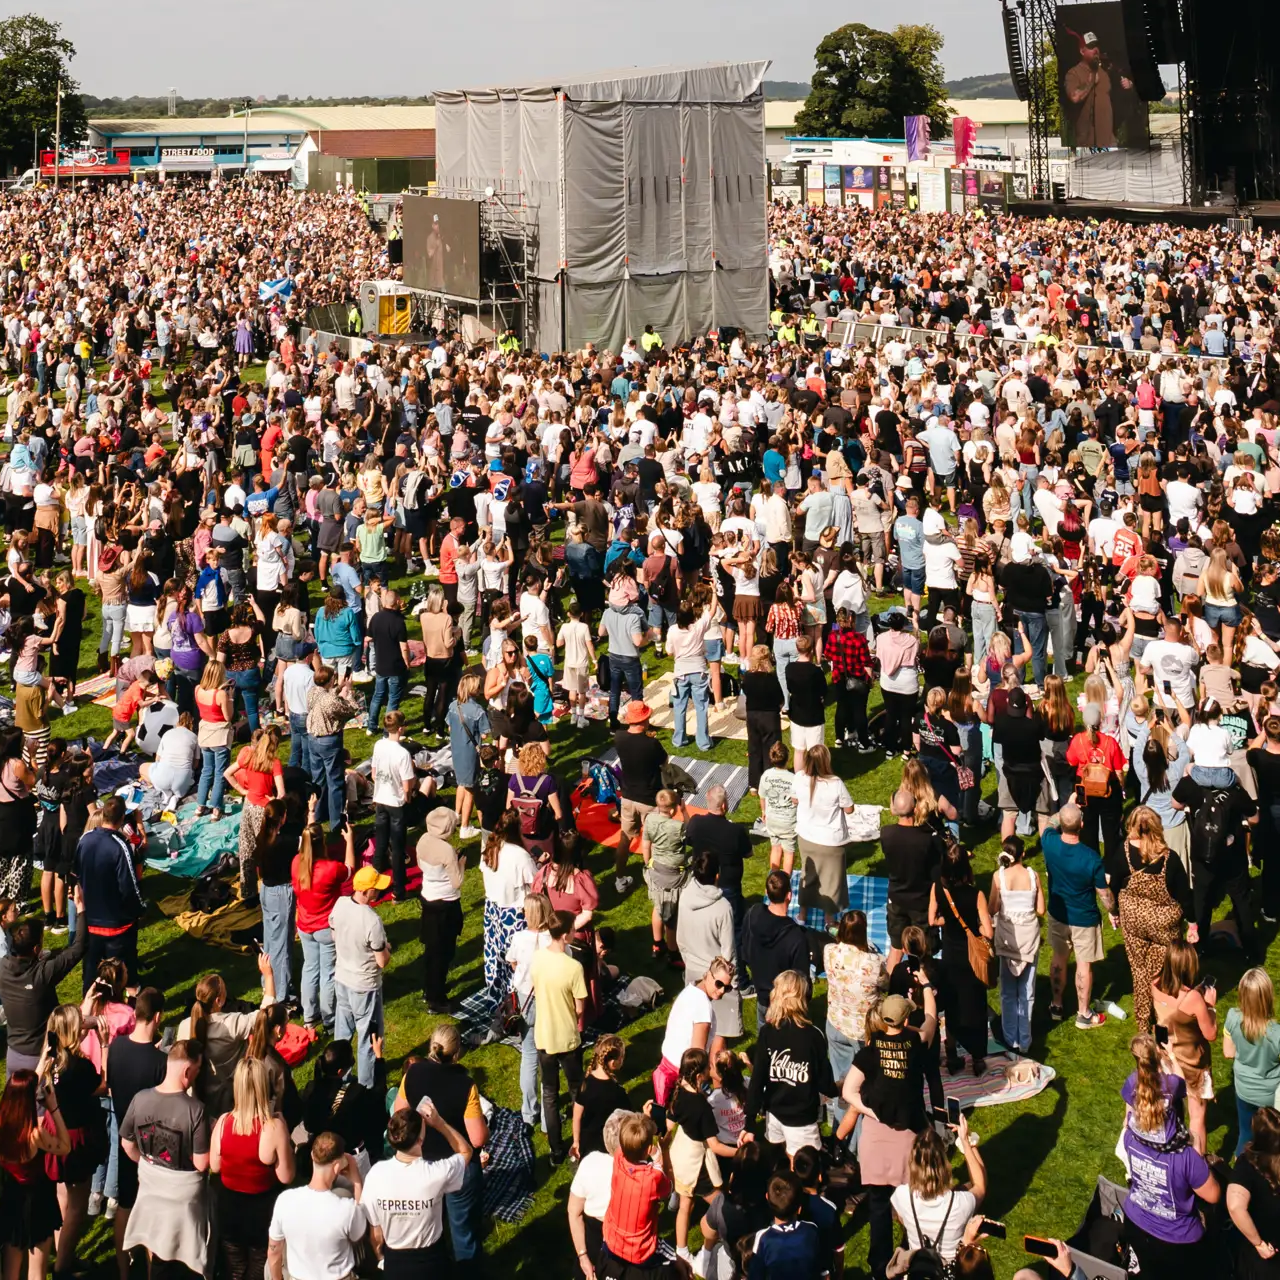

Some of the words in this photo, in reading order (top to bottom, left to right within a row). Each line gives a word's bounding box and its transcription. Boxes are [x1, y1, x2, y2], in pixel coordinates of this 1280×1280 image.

[162, 148, 192, 156] STREET
[192, 148, 215, 156] FOOD
[1114, 541, 1133, 556] 25
[875, 1039, 902, 1049] HEATHER
[880, 1059, 908, 1069] FESTIVAL
[377, 1198, 434, 1211] REPRESENT
